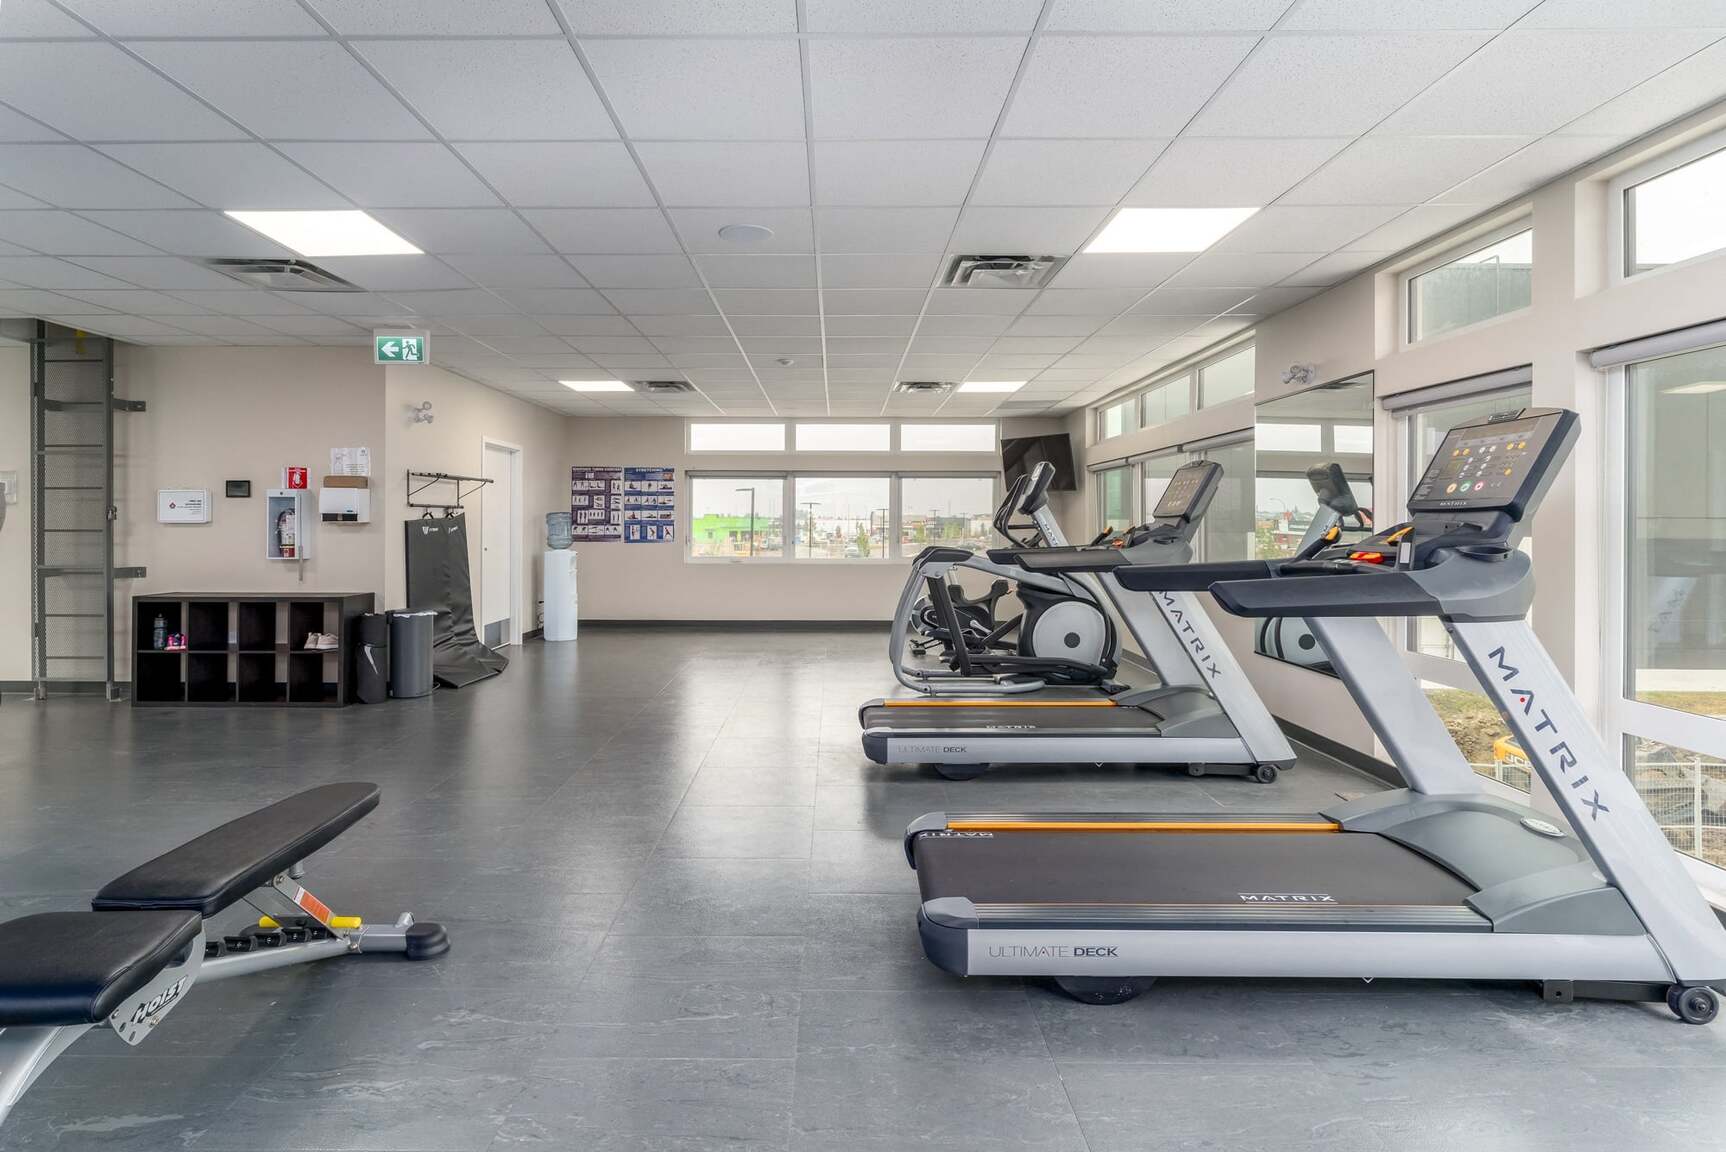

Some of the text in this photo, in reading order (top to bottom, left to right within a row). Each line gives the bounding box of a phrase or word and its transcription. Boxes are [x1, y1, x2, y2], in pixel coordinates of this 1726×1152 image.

[1488, 646, 1610, 821] MATRIX
[898, 745, 941, 753] ULTIMATE
[1239, 894, 1337, 902] MATRIX
[988, 946, 1119, 958] ULTIMATE DECK
[131, 975, 187, 1024] HOIST
